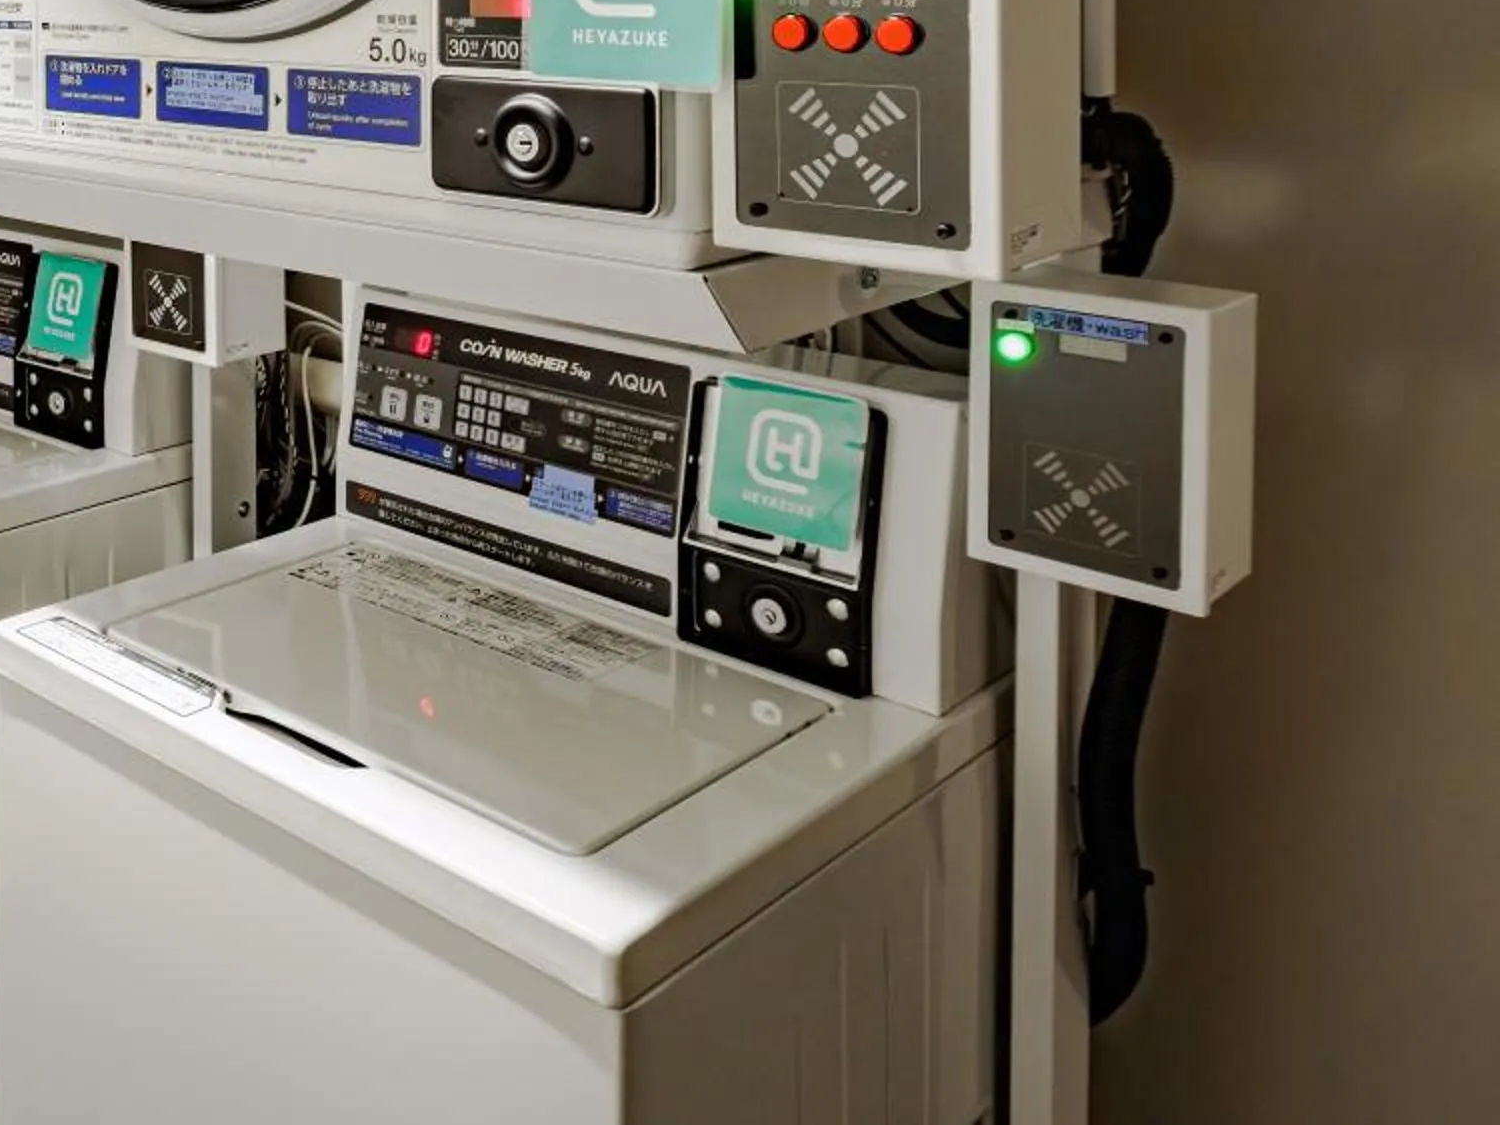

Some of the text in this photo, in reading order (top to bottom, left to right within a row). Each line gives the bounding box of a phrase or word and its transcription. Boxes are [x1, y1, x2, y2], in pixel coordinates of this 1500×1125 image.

[572, 27, 670, 48] HEYAZUKE
[504, 349, 571, 375] WASHER
[608, 371, 668, 398] AQUA
